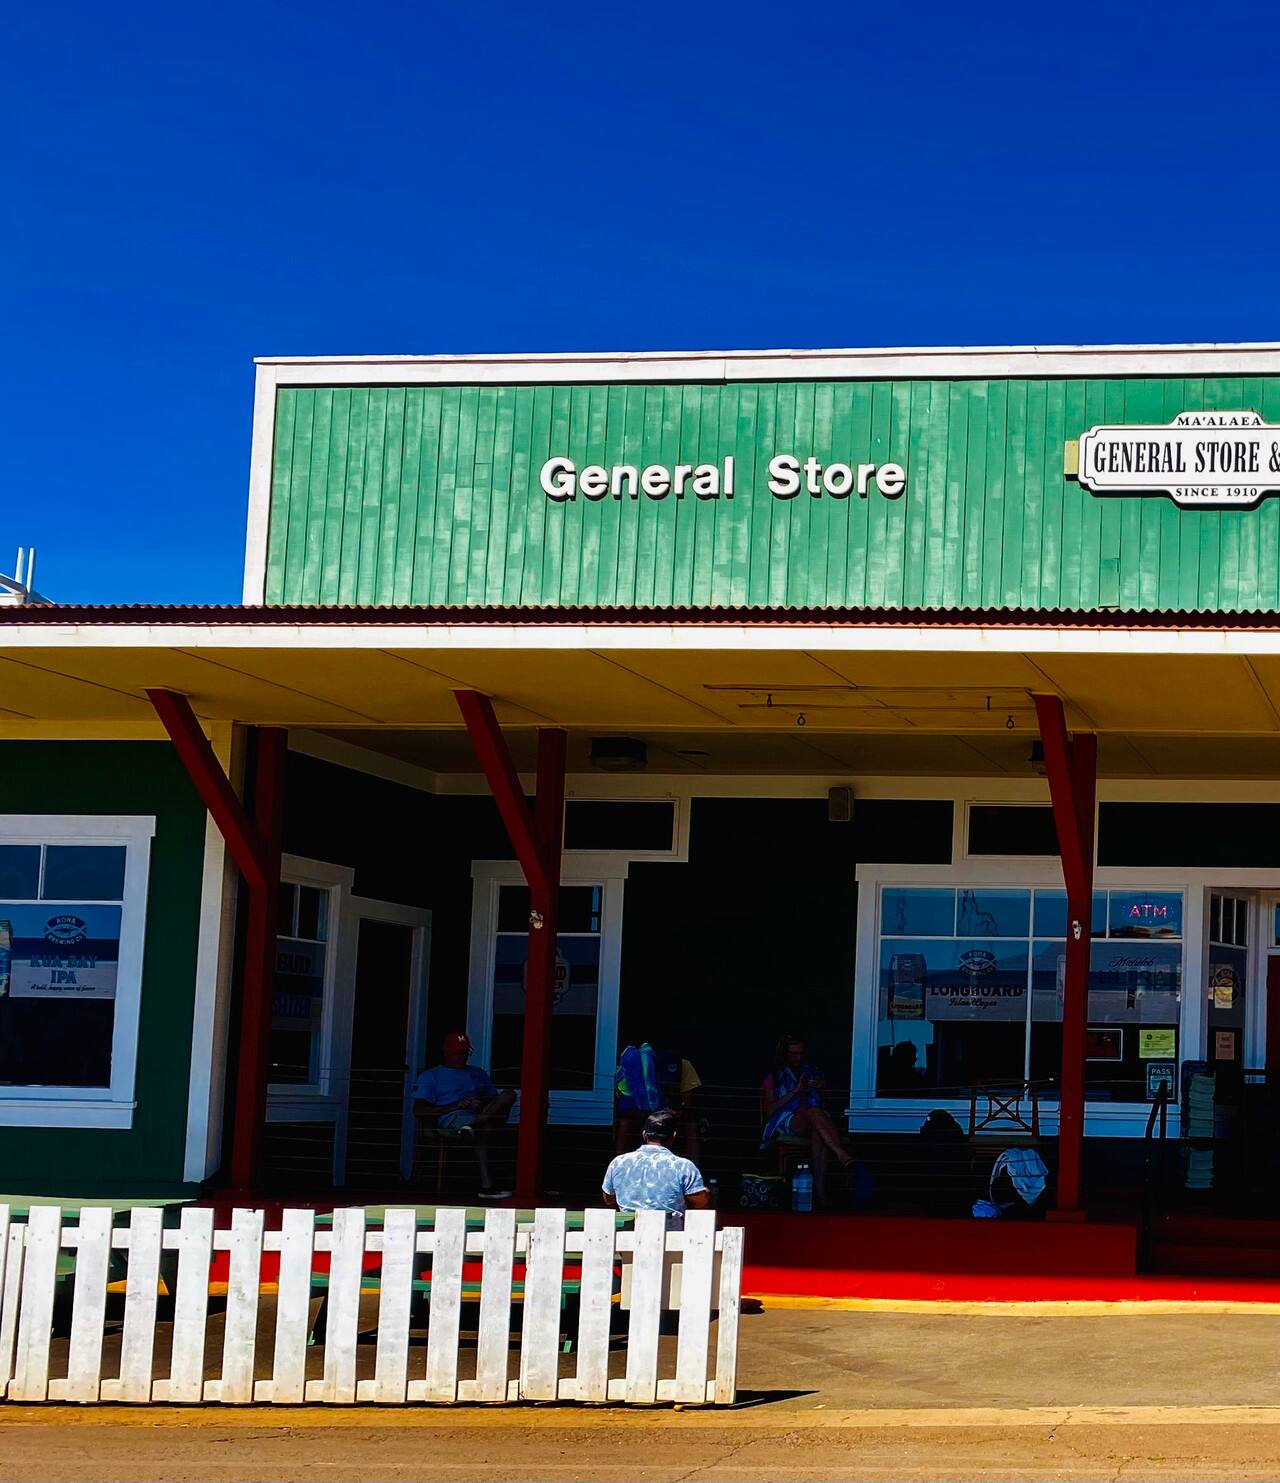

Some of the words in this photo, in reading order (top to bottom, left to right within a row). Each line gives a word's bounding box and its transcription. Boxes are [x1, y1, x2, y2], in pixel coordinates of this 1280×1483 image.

[1094, 441, 1186, 473] GENERAL
[1194, 441, 1260, 473] STORE
[540, 456, 735, 500] General
[768, 454, 906, 499] Store
[1175, 487, 1219, 497] SINCE
[1226, 487, 1258, 497] 1910
[1129, 904, 1168, 918] ATM
[66, 952, 98, 969] BAY
[50, 970, 77, 984] IPA
[931, 984, 1024, 997] LONGBOARD
